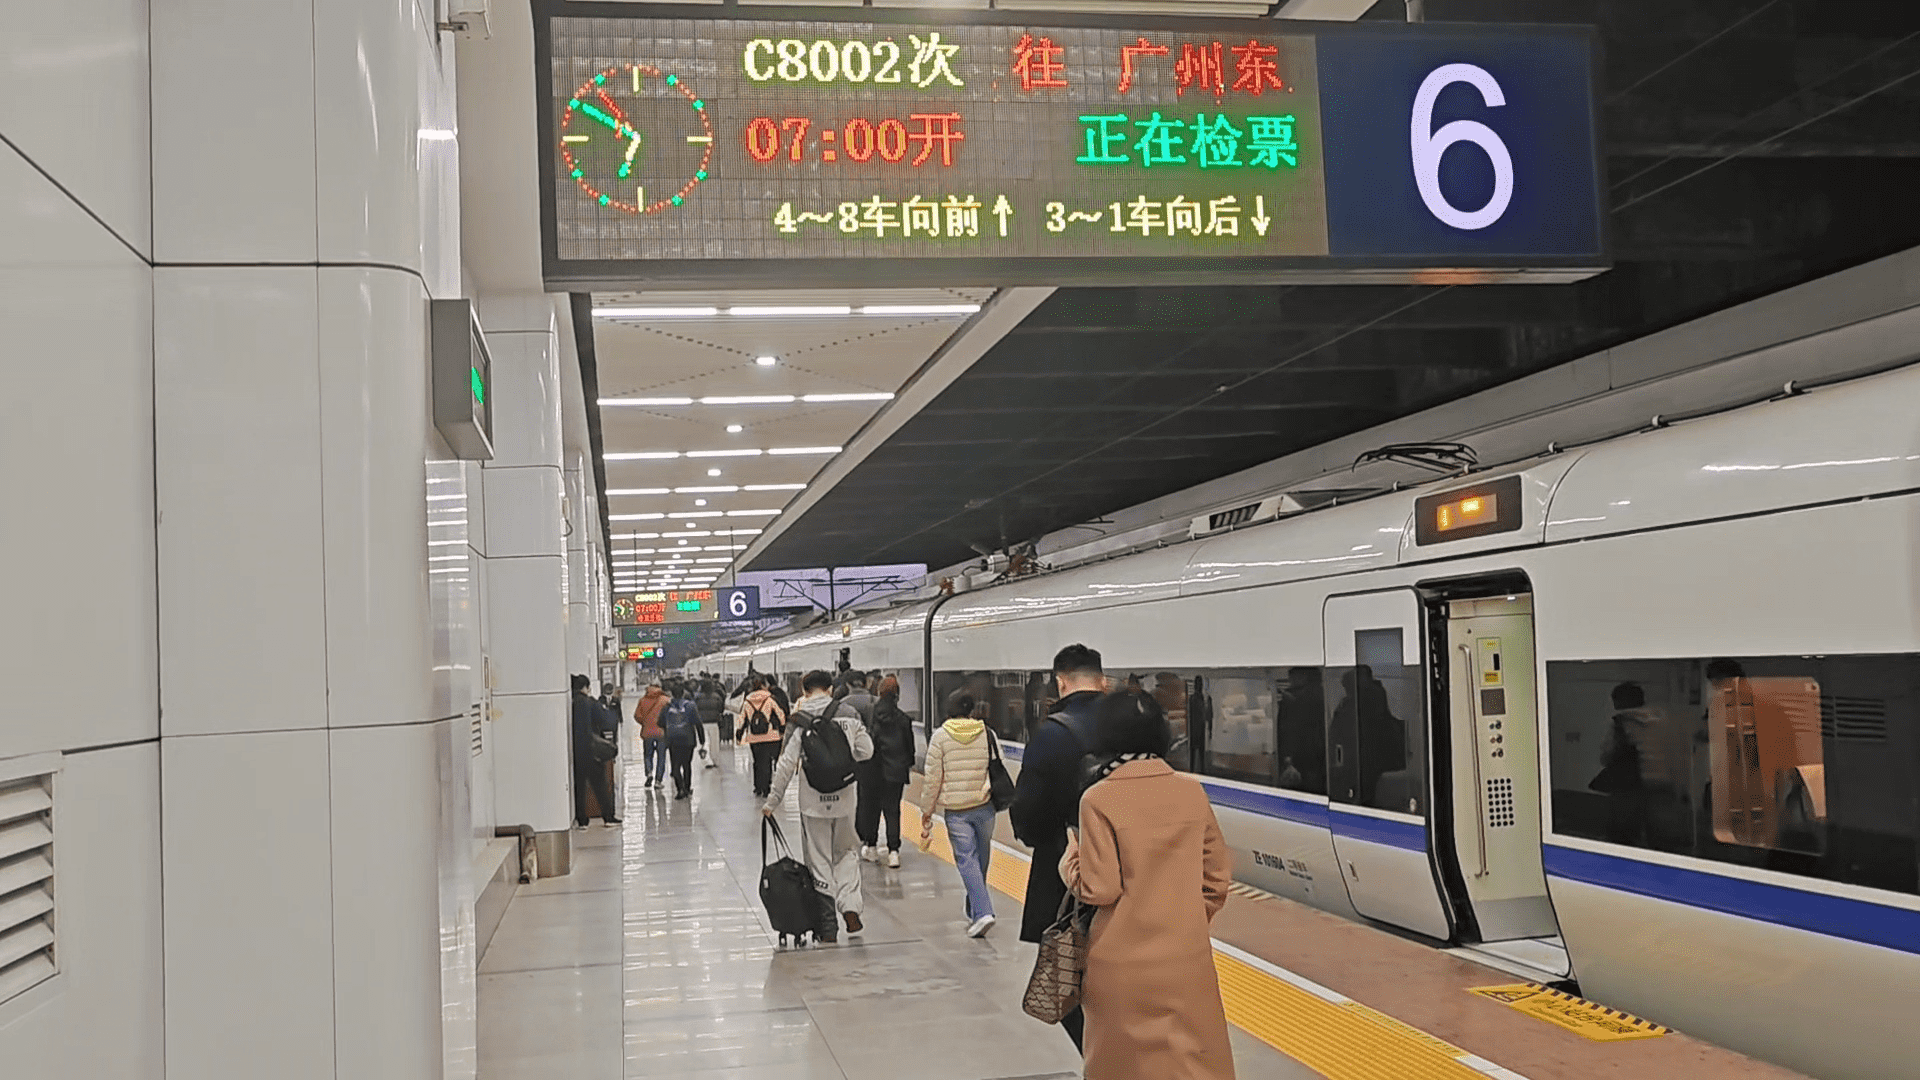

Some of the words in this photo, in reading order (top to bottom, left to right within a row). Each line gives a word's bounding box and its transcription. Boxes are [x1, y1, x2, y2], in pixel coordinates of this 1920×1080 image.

[743, 32, 964, 88] C8002次
[1012, 35, 1068, 91] 往
[1118, 39, 1284, 96] 广州东
[744, 111, 965, 167] 07:00开
[1076, 112, 1298, 167] 正在检票
[1410, 63, 1514, 230] 6
[729, 591, 747, 616] 6
[656, 648, 664, 657] 6
